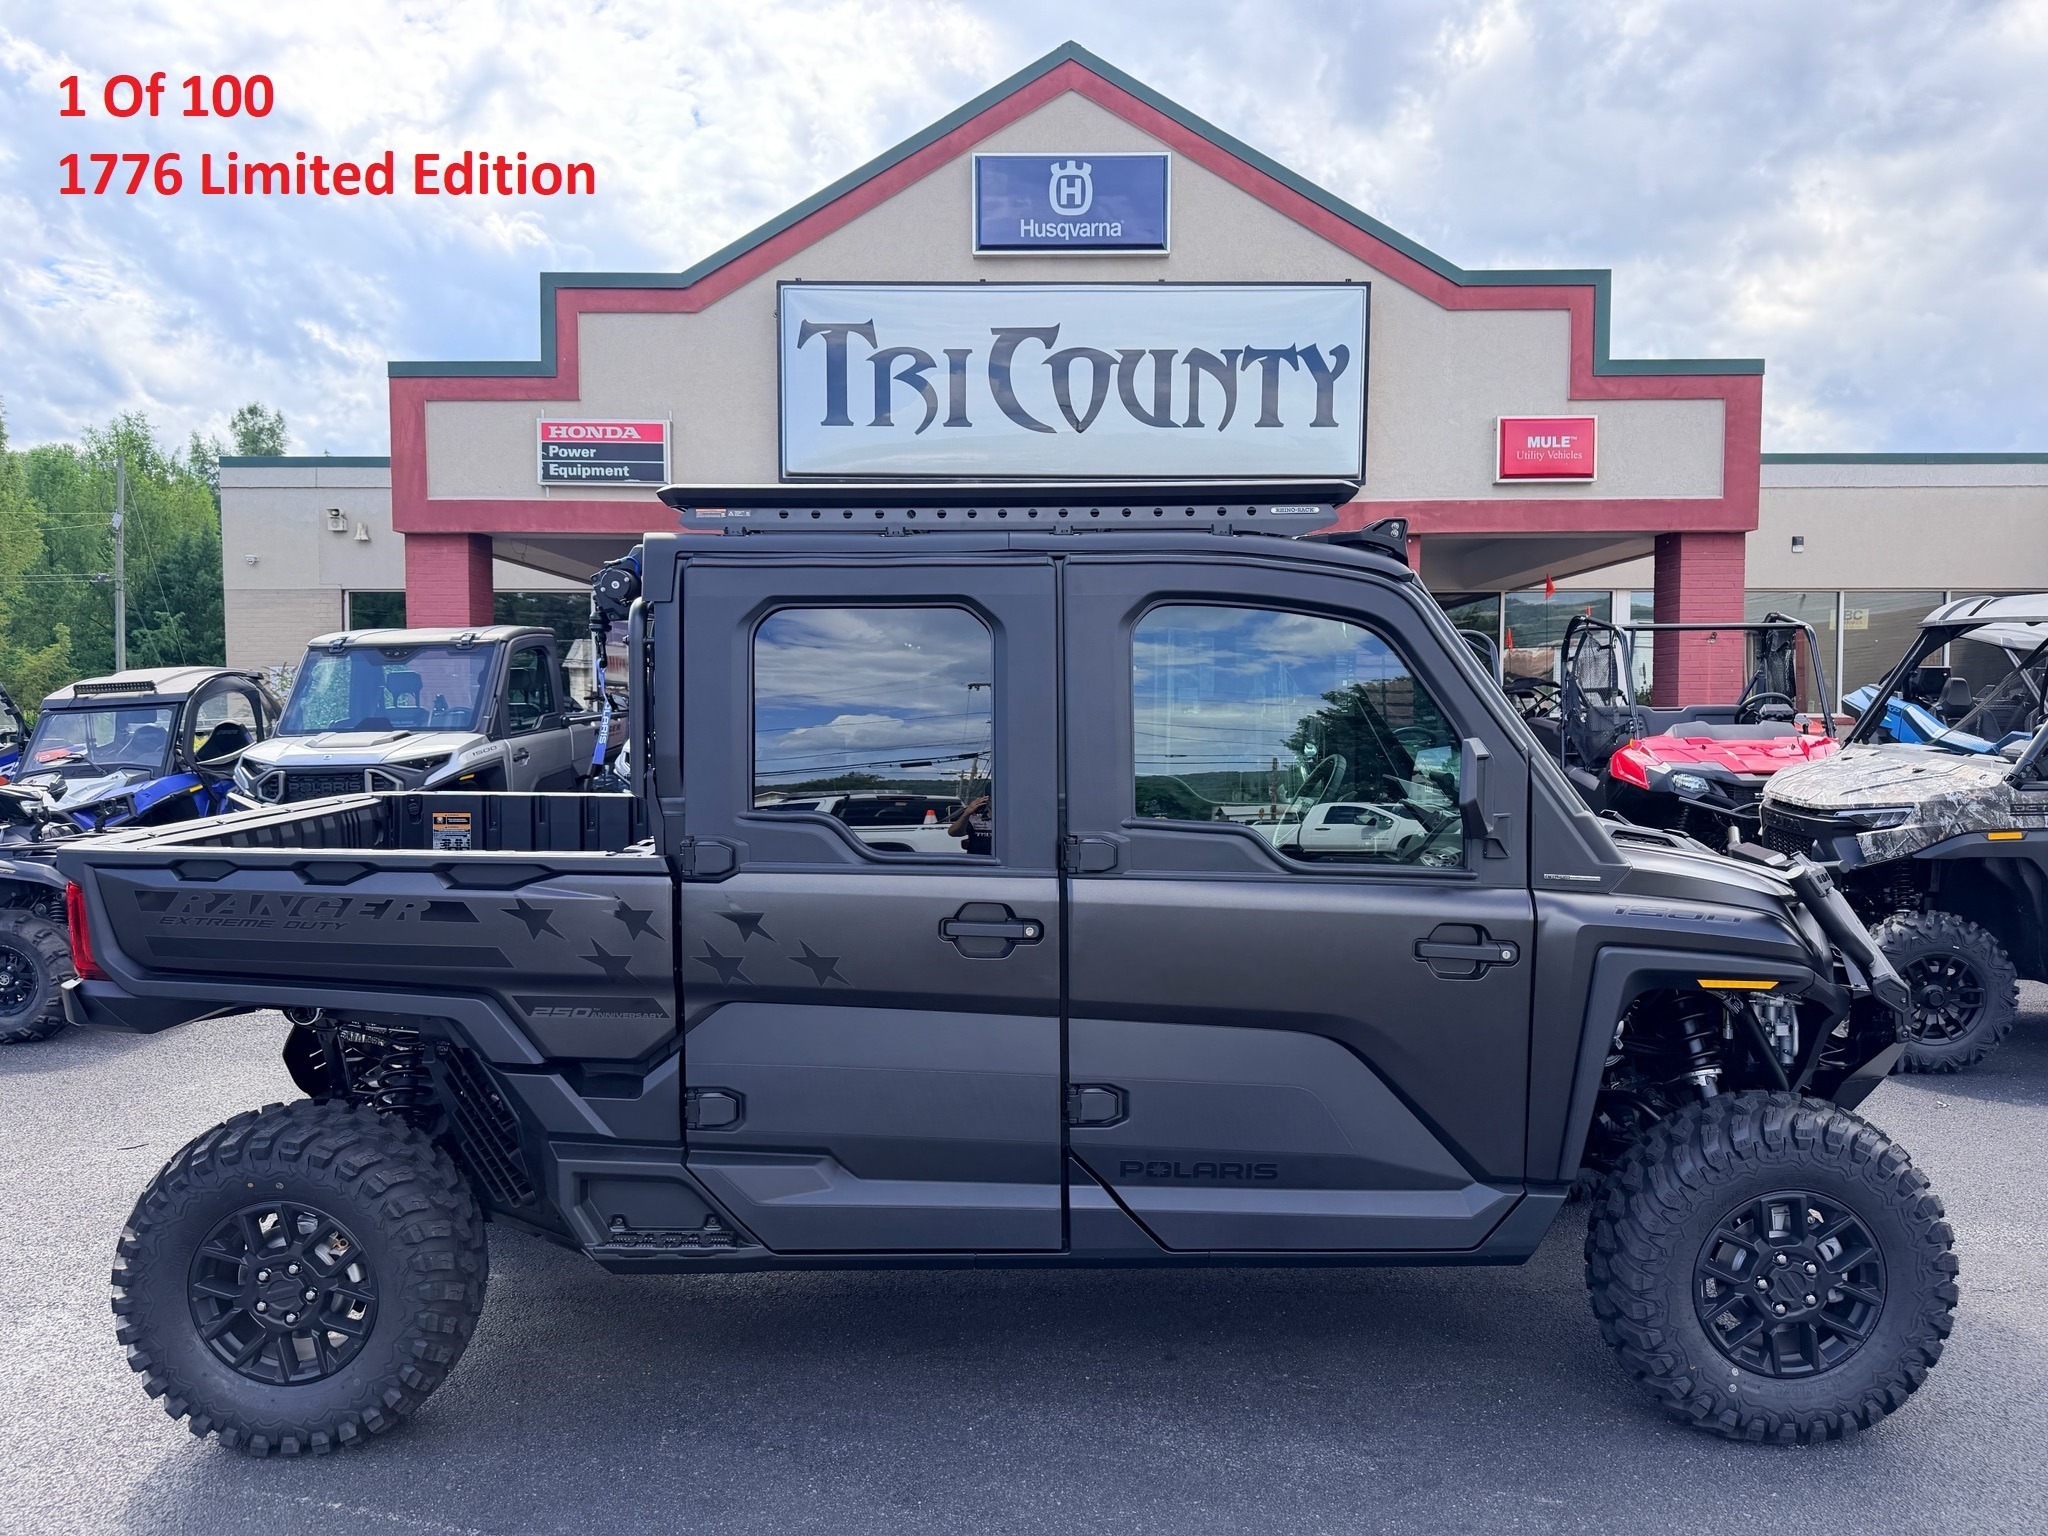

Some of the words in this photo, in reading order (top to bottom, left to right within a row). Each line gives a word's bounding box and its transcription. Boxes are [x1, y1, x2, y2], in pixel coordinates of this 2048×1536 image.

[1020, 218, 1122, 240] Husqvarna
[548, 426, 642, 439] HONDA
[549, 445, 597, 458] Power
[1516, 450, 1545, 461] Utility
[1547, 450, 1583, 460] Vehicles
[549, 463, 630, 478] Equipment
[599, 701, 611, 744] OLARIS
[472, 745, 498, 756] 1500
[288, 780, 361, 793] POLARIS
[167, 891, 431, 922] RANGER
[1614, 905, 1742, 925] 1500
[158, 916, 276, 929] EXTREME
[282, 919, 349, 931] DUTY
[1119, 1160, 1278, 1180] POLARIS
